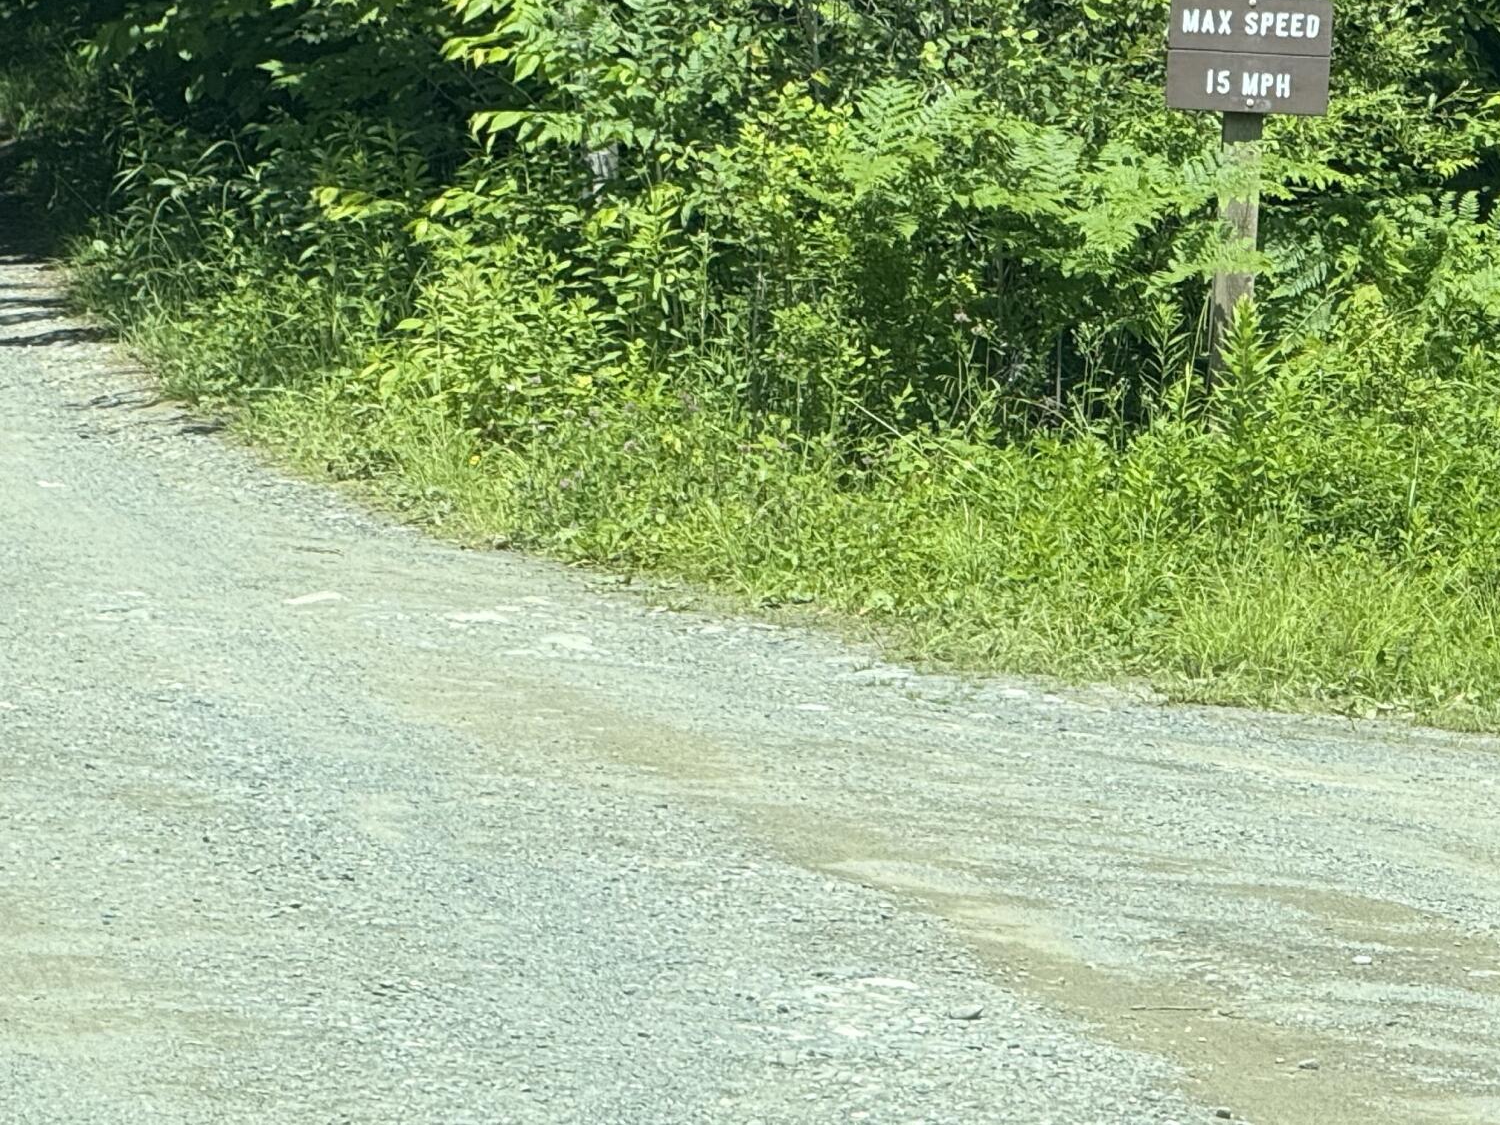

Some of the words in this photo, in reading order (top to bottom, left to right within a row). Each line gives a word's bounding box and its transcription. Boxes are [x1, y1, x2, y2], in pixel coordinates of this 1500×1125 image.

[1182, 9, 1233, 35] MAX
[1244, 11, 1320, 39] SPEED
[1206, 69, 1230, 94] 15
[1241, 72, 1291, 98] MPH
